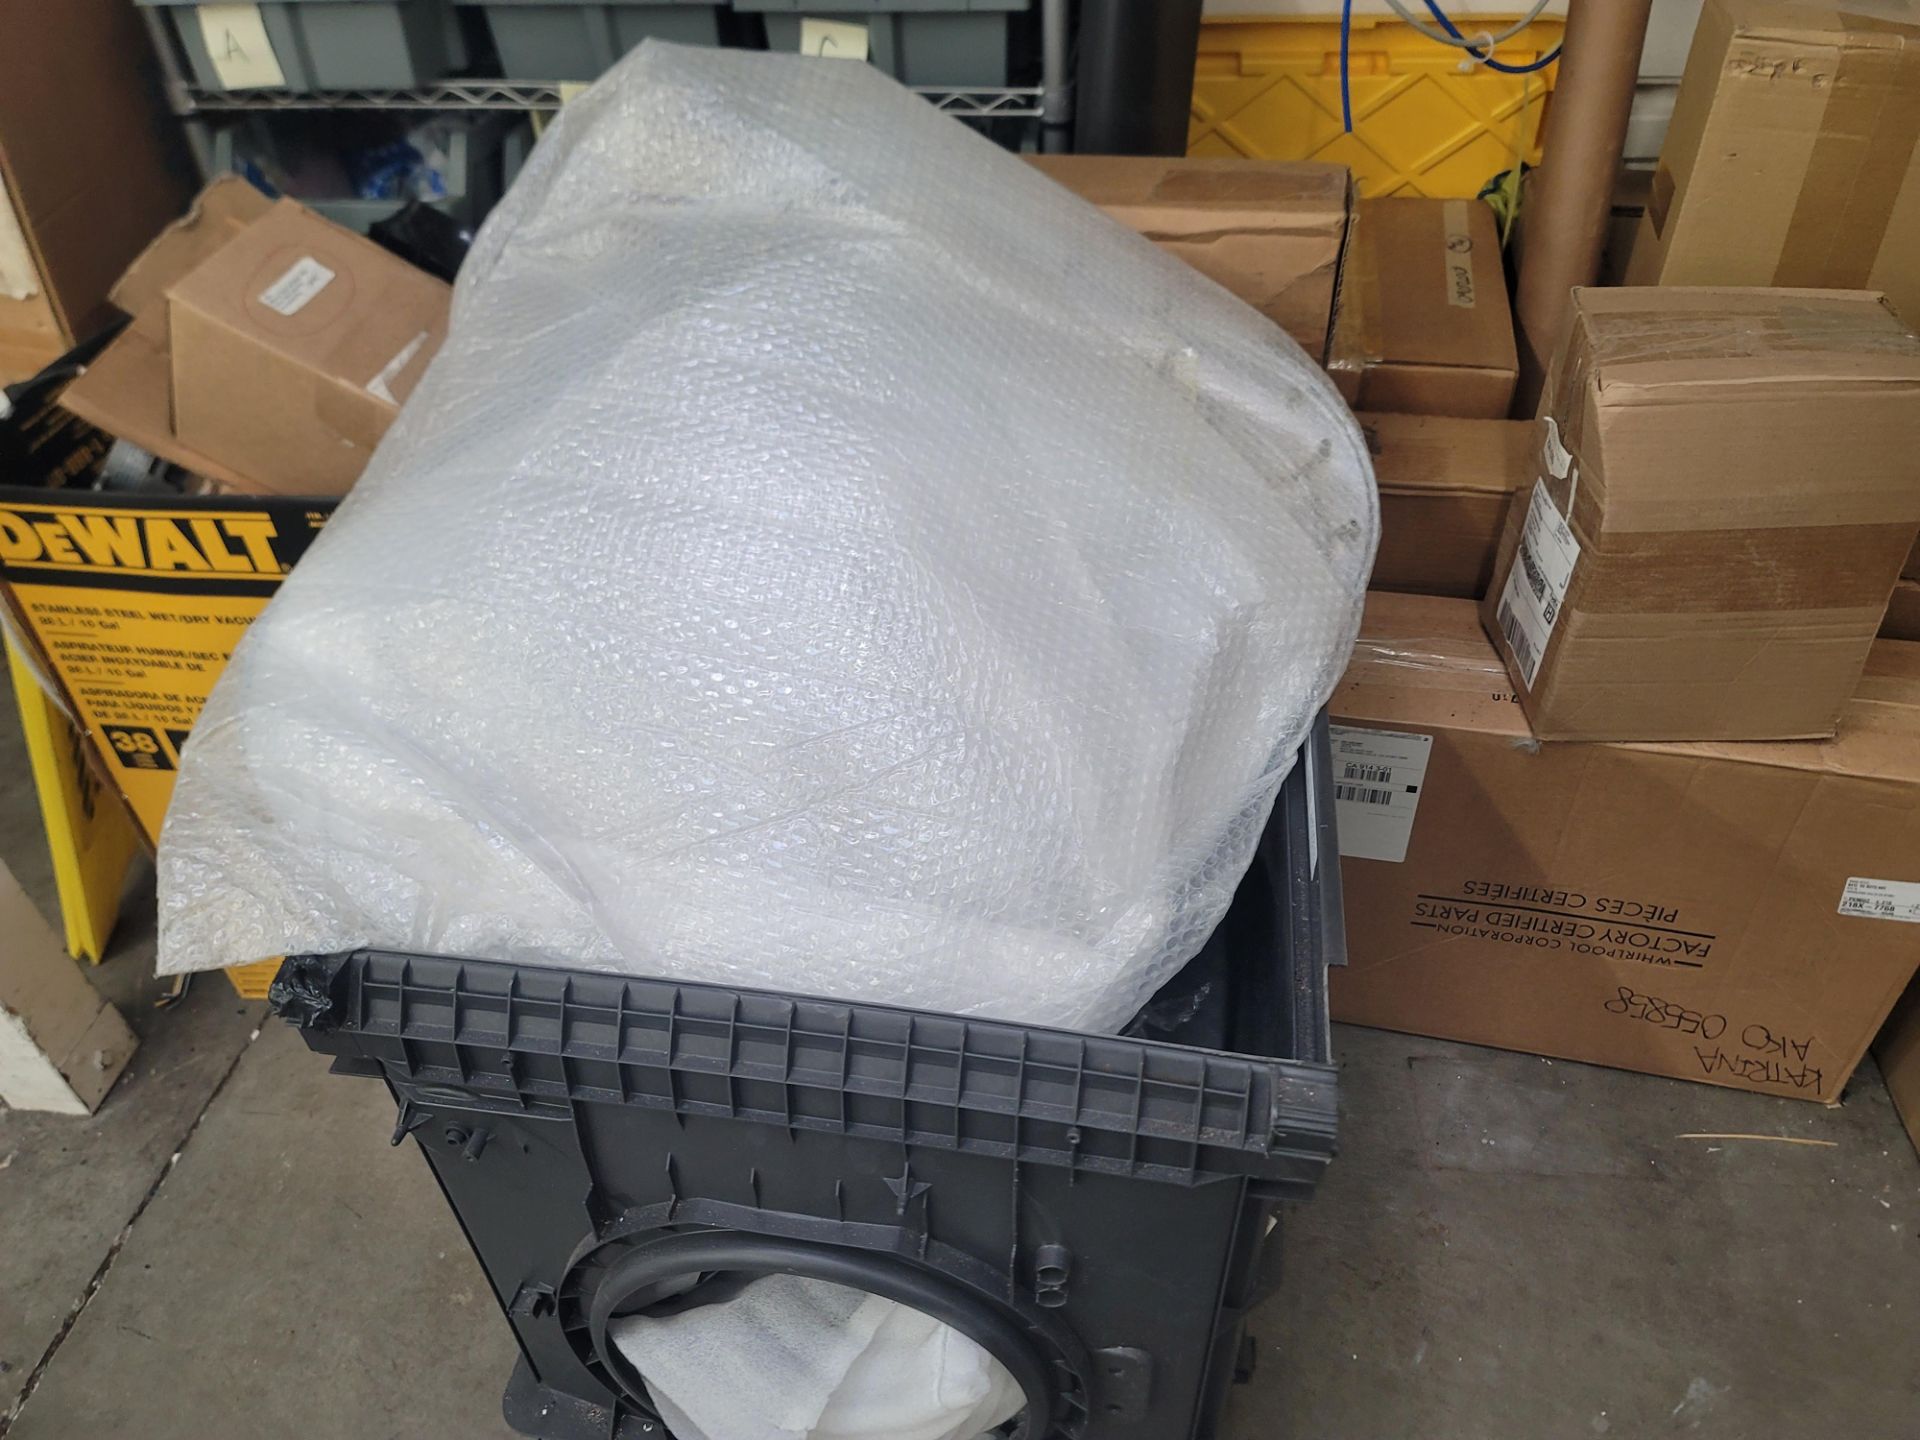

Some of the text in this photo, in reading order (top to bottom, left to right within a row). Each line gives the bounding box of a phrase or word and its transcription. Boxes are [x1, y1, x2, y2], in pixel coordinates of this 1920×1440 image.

[217, 28, 251, 62] A
[31, 603, 101, 616] STAINLESS
[103, 609, 146, 619] STEEL
[149, 612, 209, 624] WET/DRY
[53, 640, 131, 653] ASPIRATEUR
[136, 646, 219, 661] HUMIDE/SEC
[101, 656, 183, 670] INOXYDABLE
[186, 661, 206, 672] DE
[80, 688, 161, 700] ASPIRADORA
[164, 693, 181, 702] DE
[110, 731, 159, 754] 38
[1463, 880, 1679, 924] PIÈCES CERTIFIÉES
[1415, 902, 1712, 958] FACTORY CERTIFIED PARTS
[1437, 923, 1672, 966] WHIRLPOOL CORPORATION
[1604, 987, 1727, 1040] 055858
[1693, 1046, 1823, 1095] KATRINA
